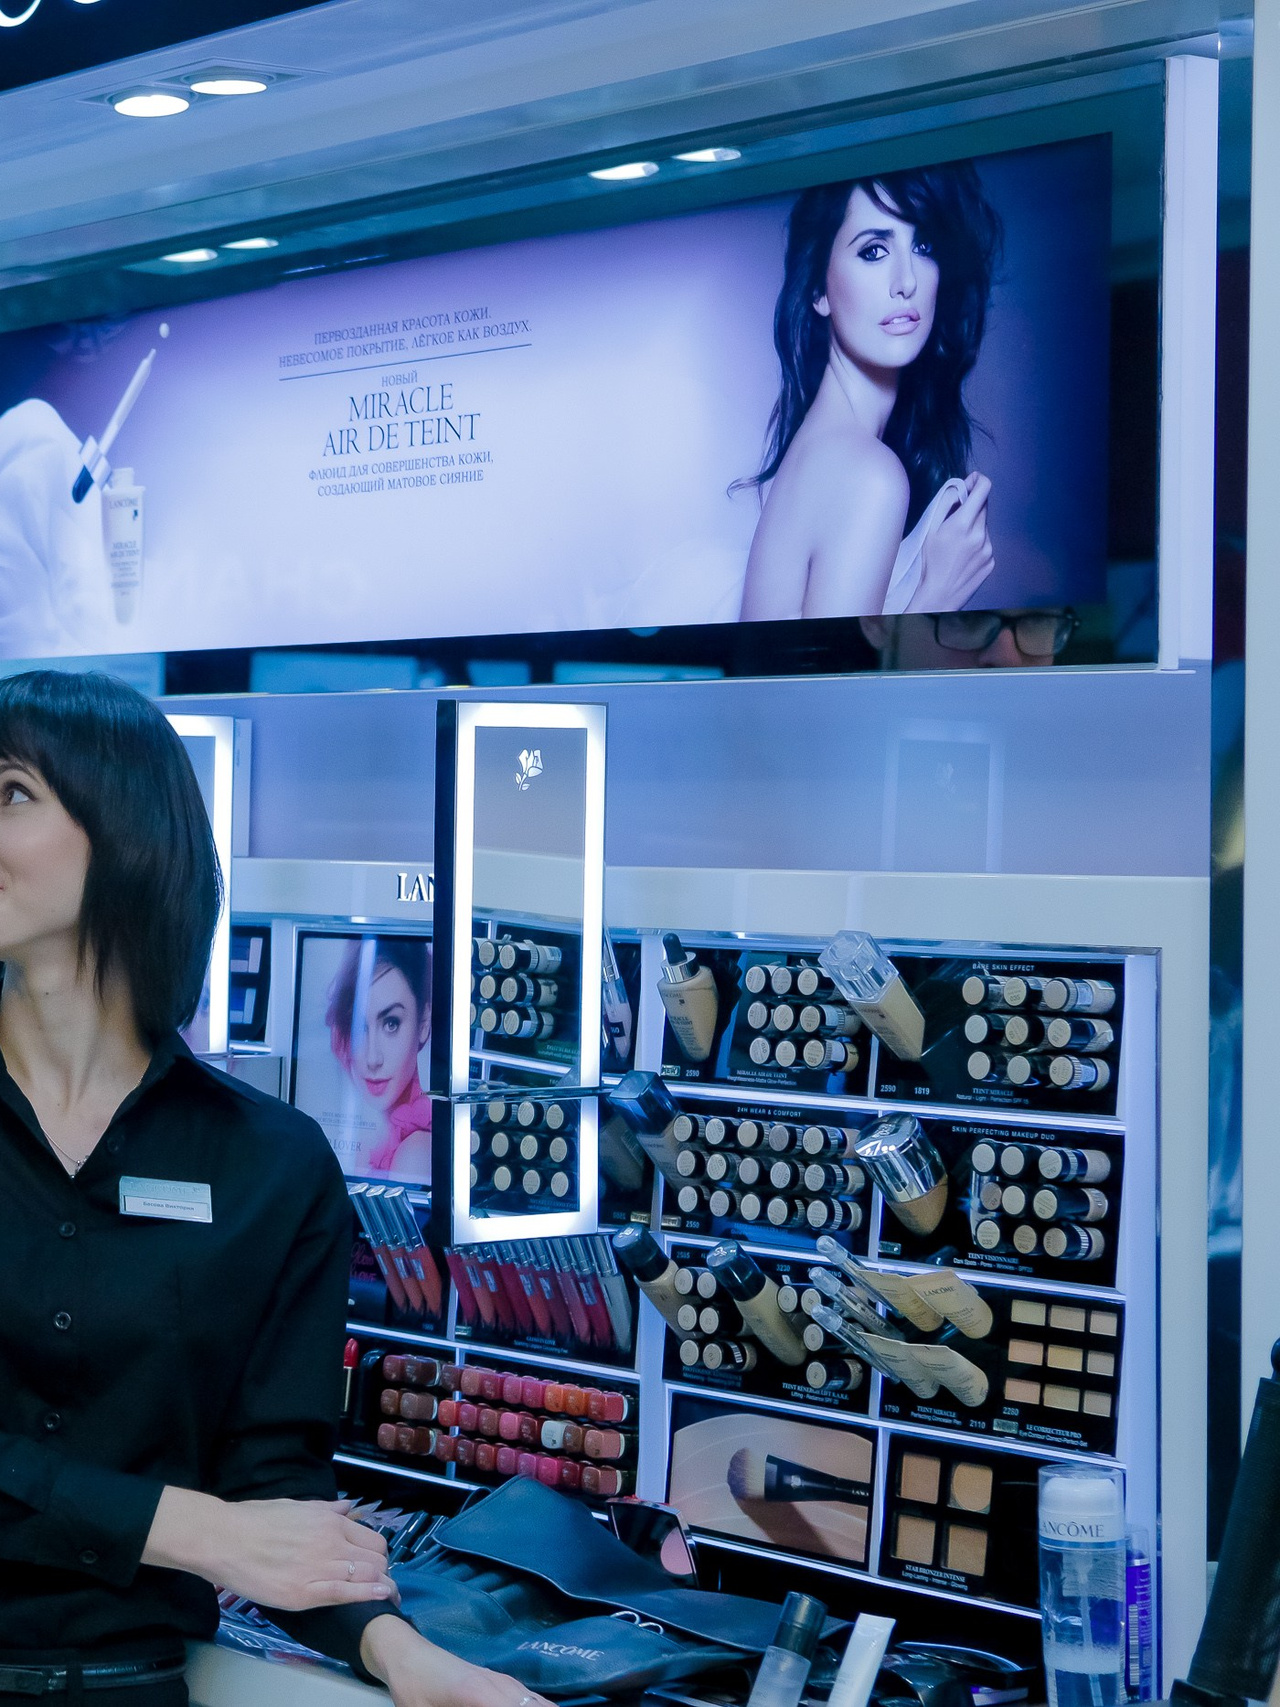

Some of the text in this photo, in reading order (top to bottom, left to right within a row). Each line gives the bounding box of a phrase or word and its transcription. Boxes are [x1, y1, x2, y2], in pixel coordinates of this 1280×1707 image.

[314, 307, 491, 345] ПЕРВОЗДАННАЯ КРАСОТА КОЖИ.
[279, 347, 344, 368] НЕВЕСОМОЕ
[412, 331, 454, 349] ЛЁГКОЕ
[458, 327, 480, 342] КАК
[483, 320, 532, 338] ВОЗДУХ.
[382, 369, 417, 387] НОВЫЙ
[349, 383, 453, 422] MIRACLE
[323, 413, 481, 457] AIR DE TEINT
[308, 451, 494, 481] ФЛЮИД ДЛЯ СОВЕРШЕНСТВА КОЖИ,
[317, 469, 484, 496] СОЗДАЮЩИЙ МАТОВОЕ СИЯНИЕ
[1009, 964, 1035, 972] EFFECT
[880, 1084, 896, 1093] 2590
[914, 1086, 930, 1095] 1819
[969, 1127, 1009, 1136] PERFECTING
[969, 1419, 986, 1429] 2110
[1041, 1520, 1105, 1538] ANCÔME
